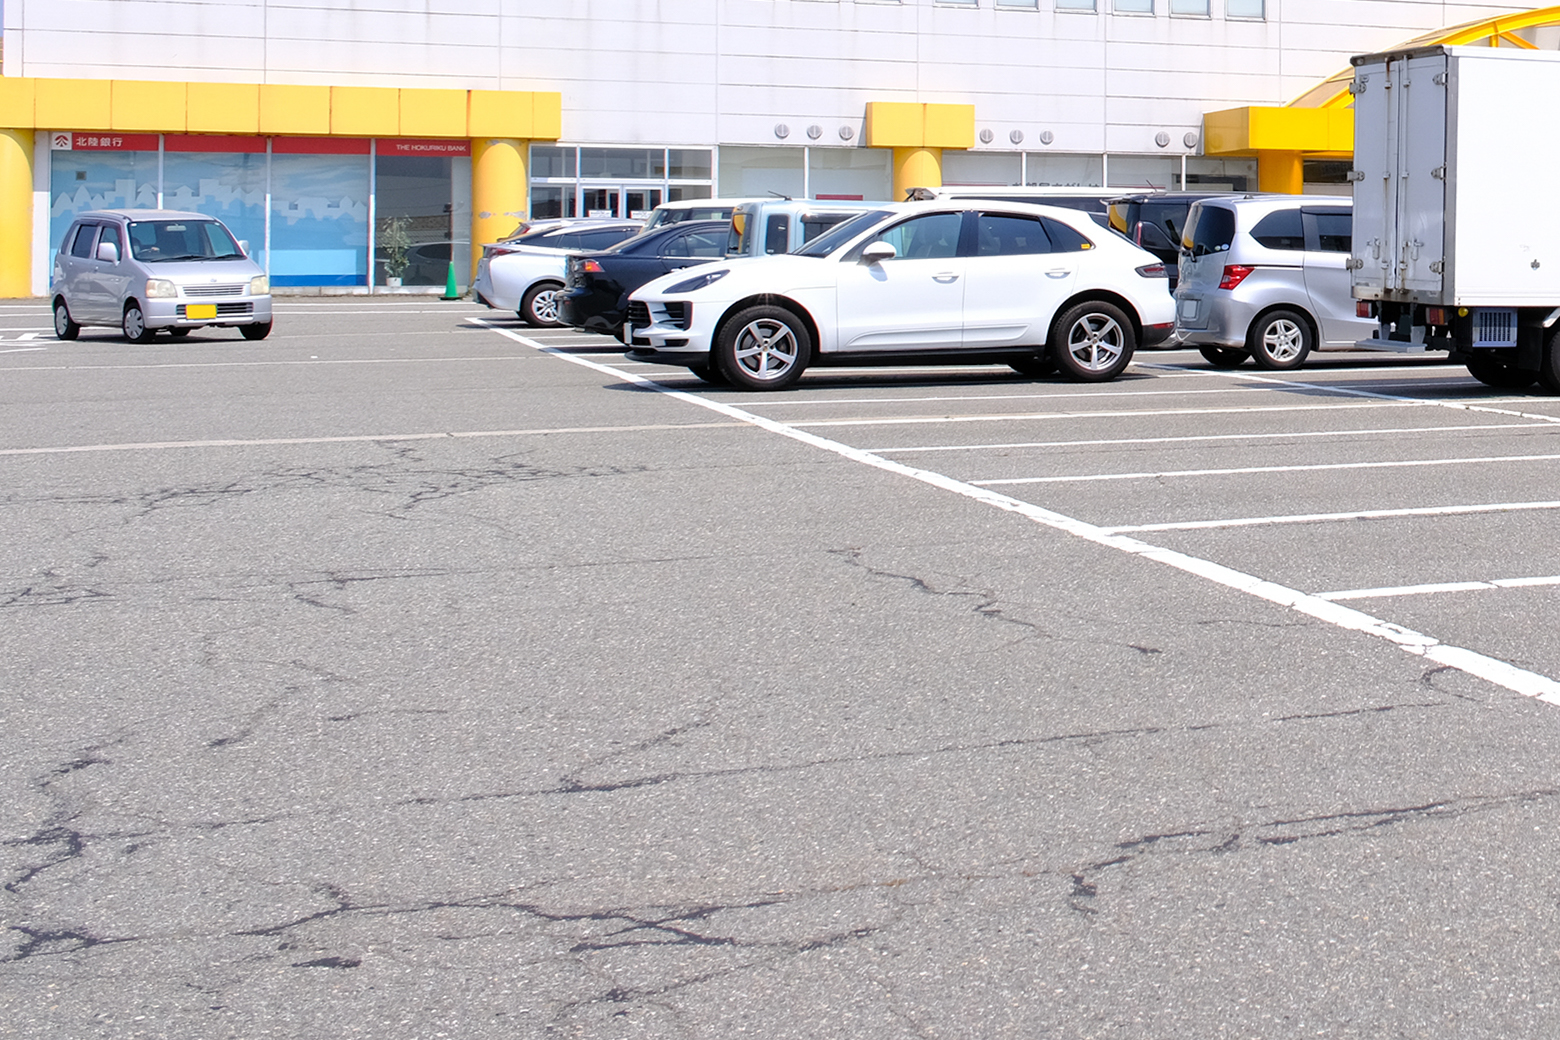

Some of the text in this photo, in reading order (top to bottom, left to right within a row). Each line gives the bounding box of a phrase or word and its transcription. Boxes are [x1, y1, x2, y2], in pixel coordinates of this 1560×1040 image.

[76, 136, 123, 148] 北陸銀行
[411, 144, 447, 152] HOKURIKU
